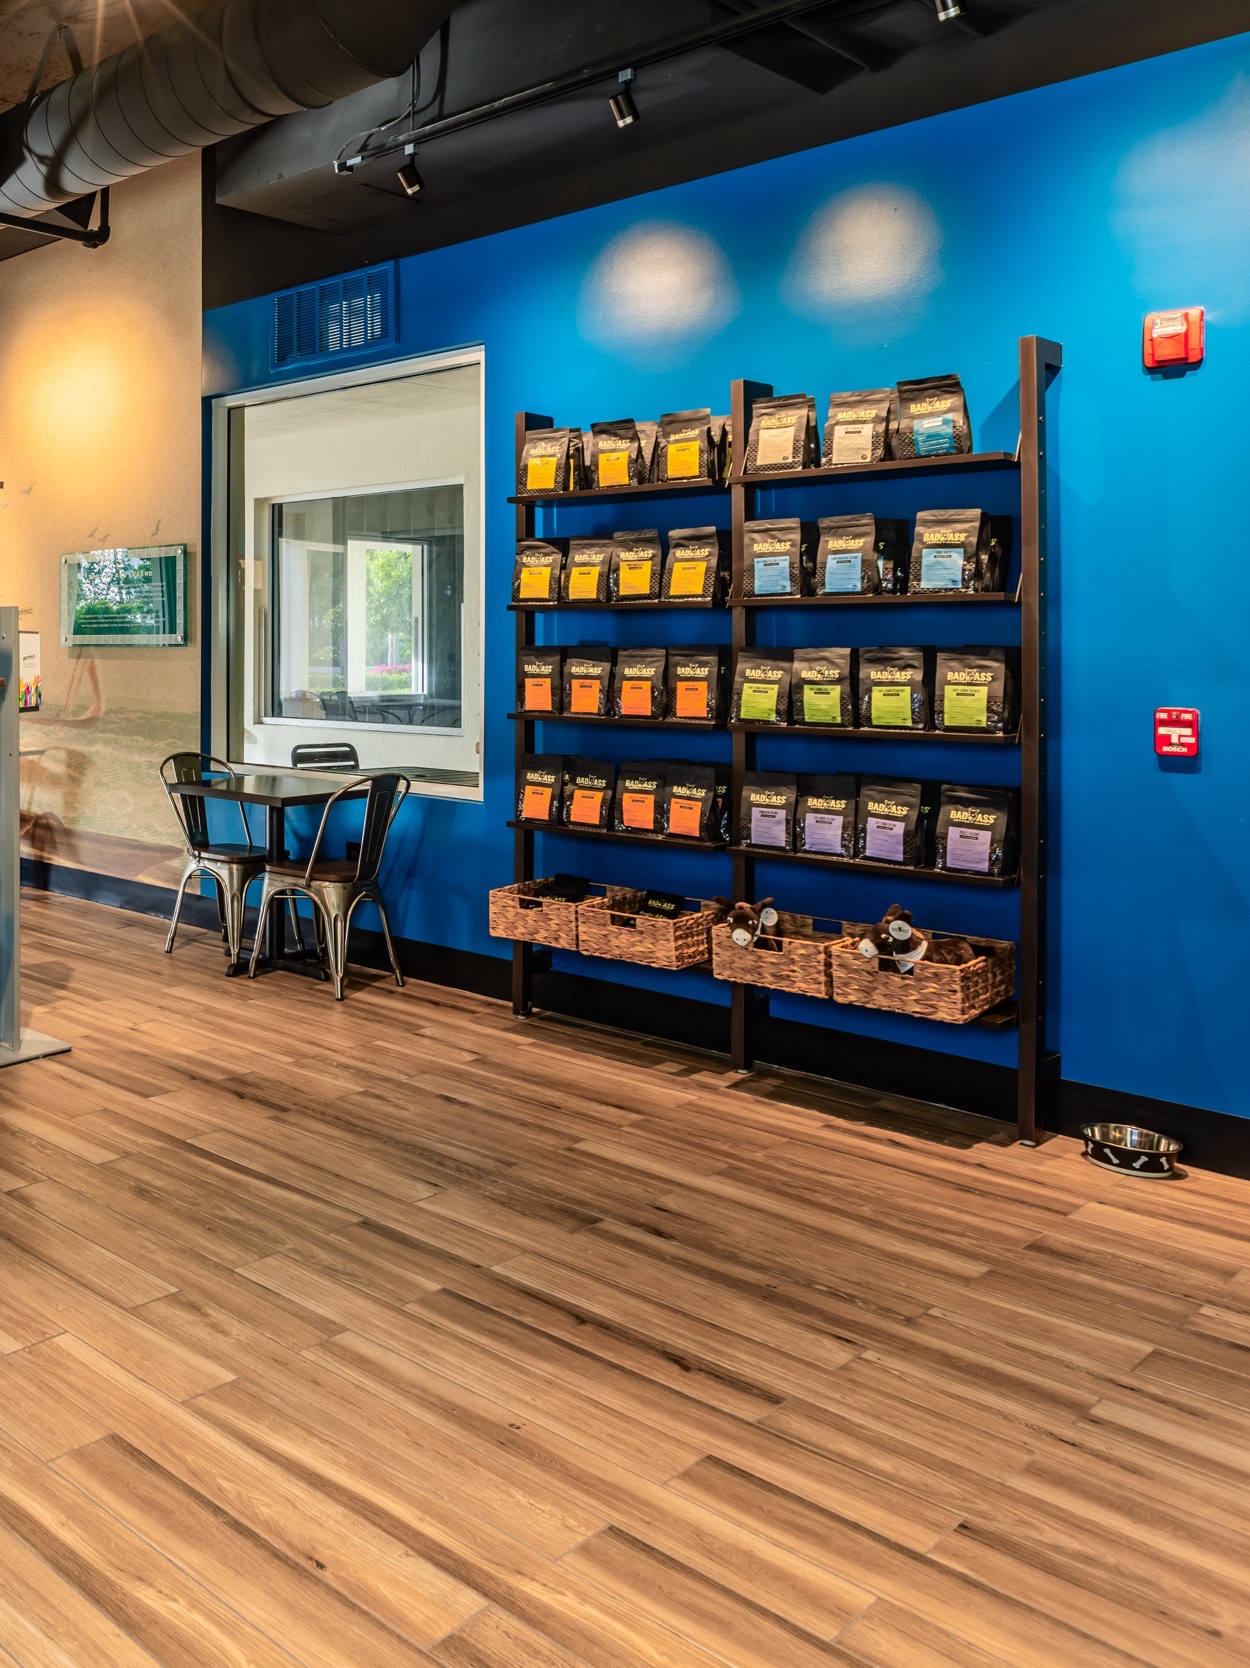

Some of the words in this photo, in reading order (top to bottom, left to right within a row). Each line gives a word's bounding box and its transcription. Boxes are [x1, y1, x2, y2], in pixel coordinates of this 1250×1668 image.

[910, 402, 926, 413] BAD
[934, 399, 954, 408] ASS
[760, 419, 775, 427] BAD
[782, 415, 799, 424] ASS
[923, 533, 940, 541] BAD
[948, 533, 968, 541] ASS
[753, 543, 767, 551] BAD
[775, 542, 792, 550] ASS
[828, 540, 842, 548] BAD
[745, 668, 760, 677] BAD
[767, 670, 784, 678] ASS
[801, 670, 816, 678] BAD
[824, 670, 841, 678] ASS
[870, 671, 886, 680] BAD
[895, 671, 913, 679] ASS
[947, 672, 964, 681] BAD
[973, 672, 994, 681] ASS
[672, 785, 685, 793] BAD
[692, 788, 707, 796] ASS
[750, 793, 764, 801] BAD
[771, 795, 787, 804] ASS
[807, 798, 822, 806] BAD
[830, 799, 847, 808] ASS
[867, 802, 884, 811] BAD
[891, 805, 910, 815] ASS
[950, 810, 968, 820] BAD
[976, 814, 997, 824] ASS
